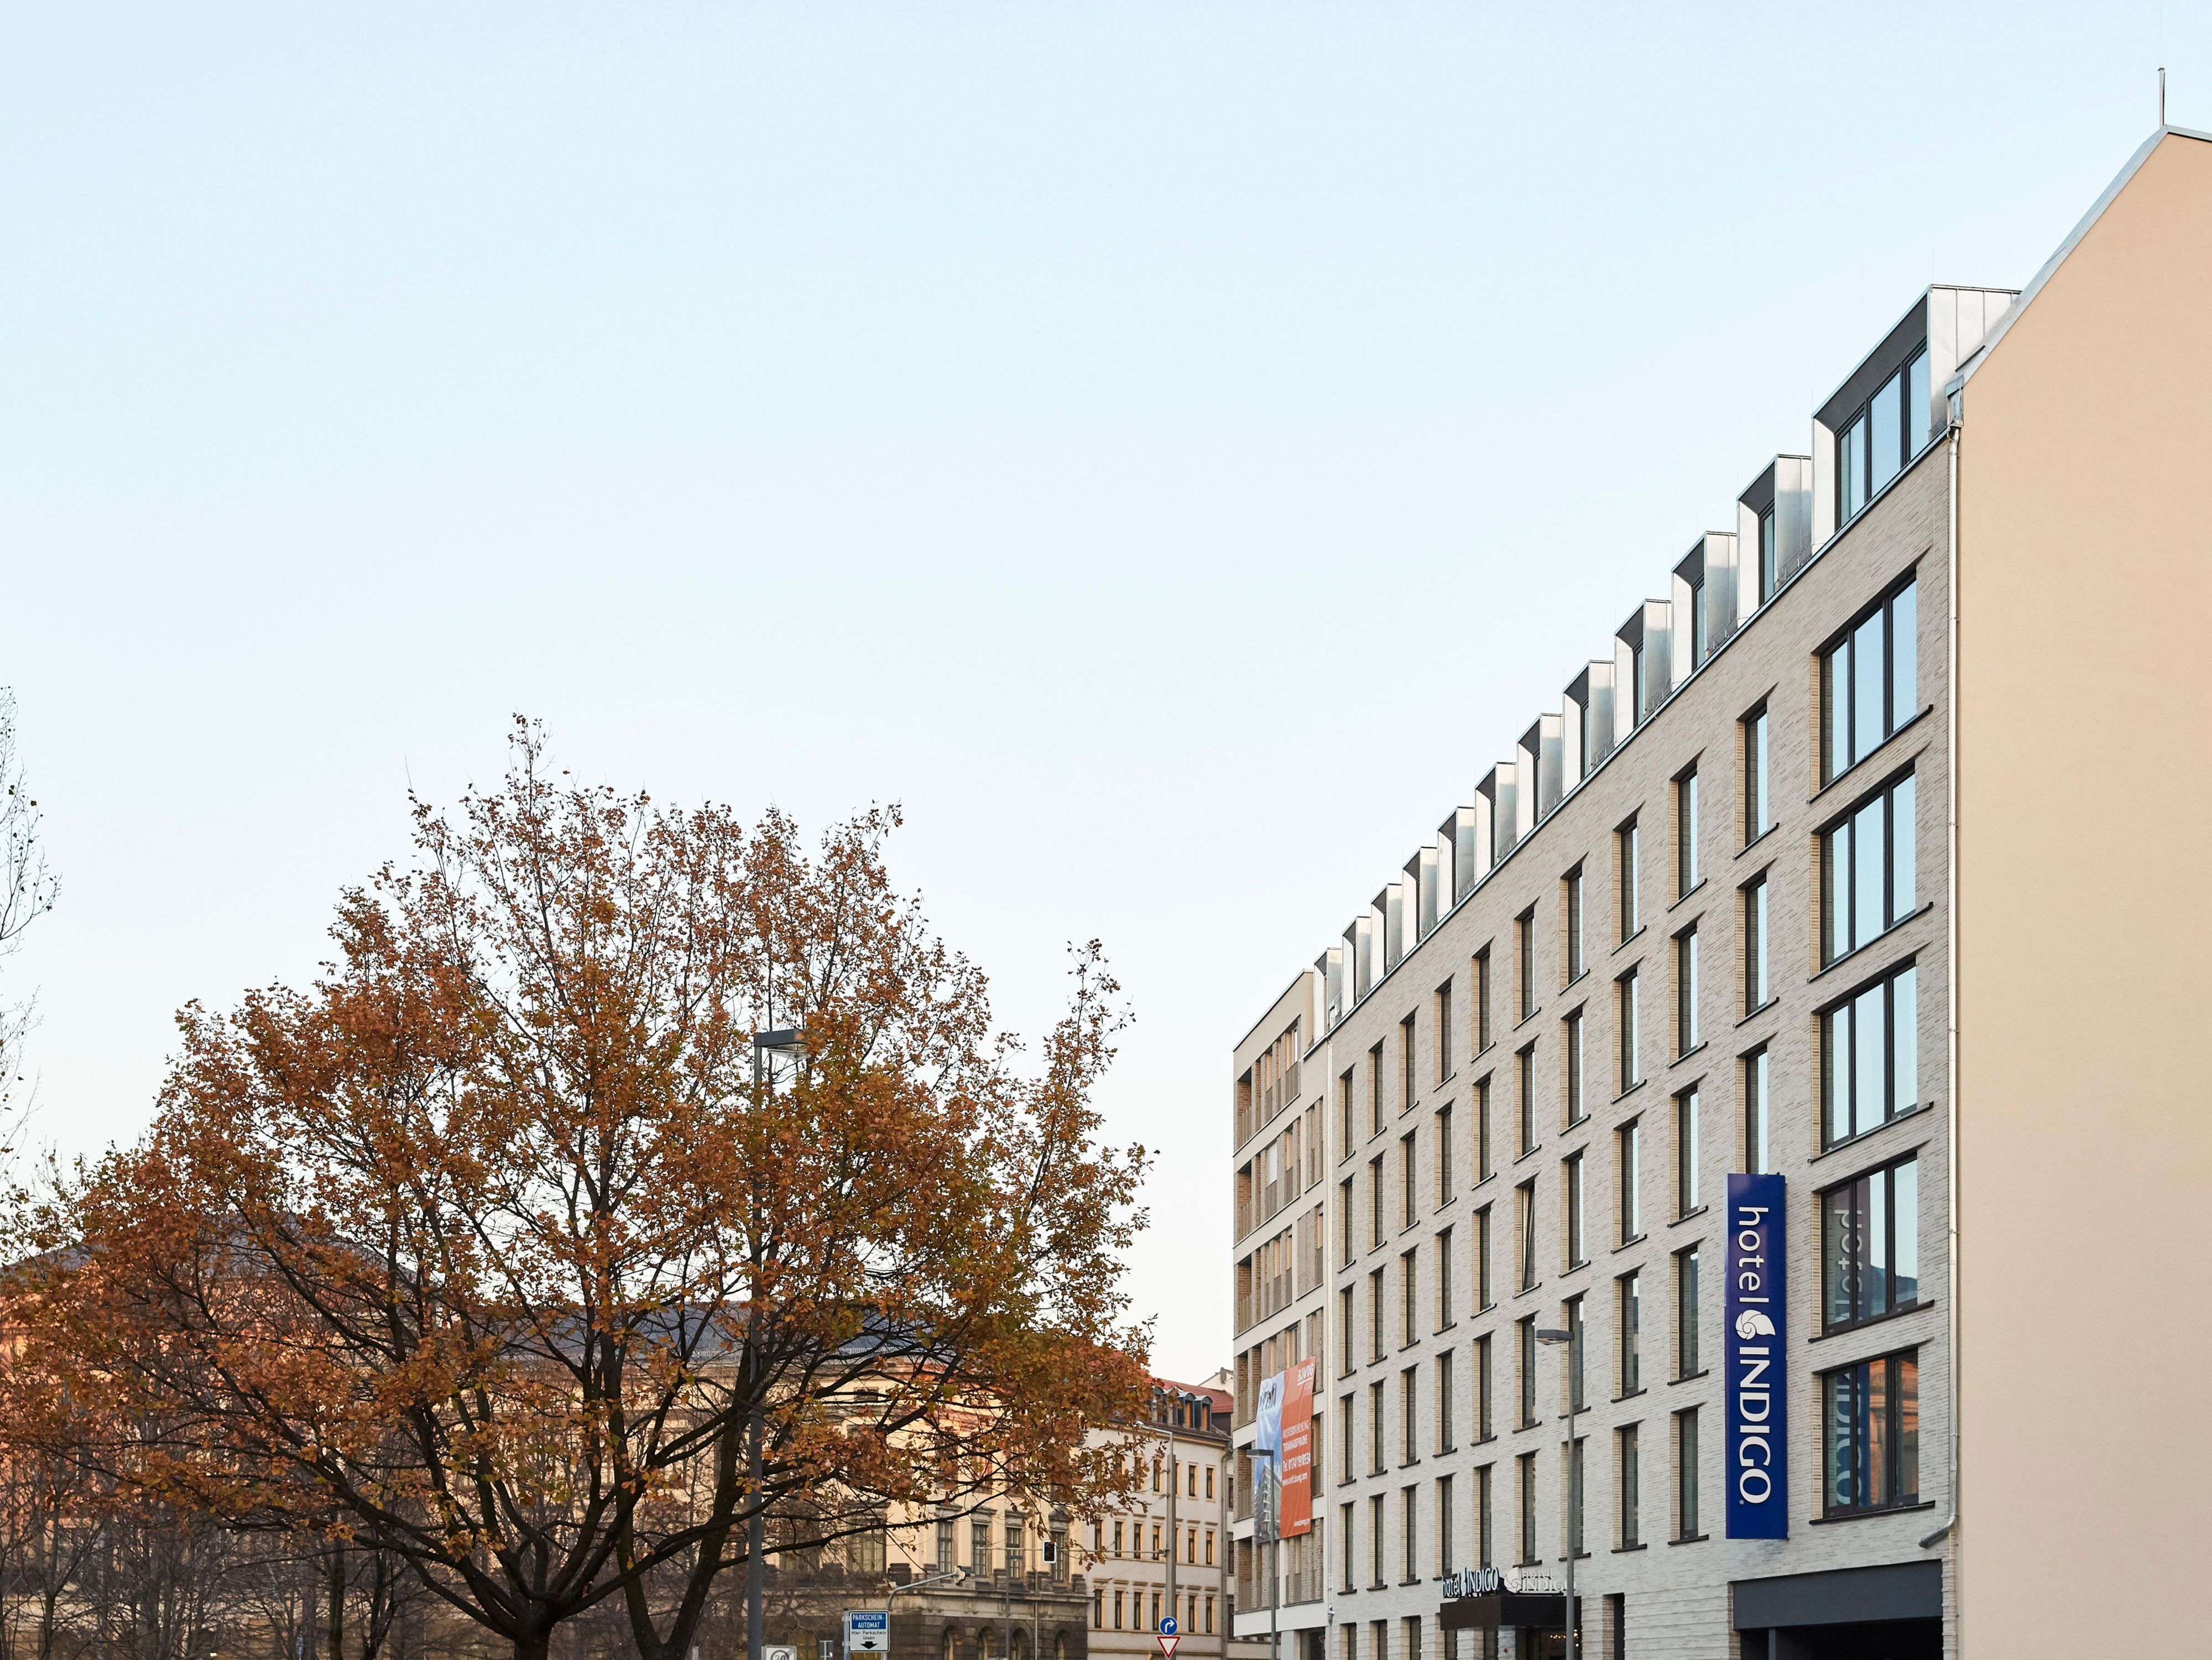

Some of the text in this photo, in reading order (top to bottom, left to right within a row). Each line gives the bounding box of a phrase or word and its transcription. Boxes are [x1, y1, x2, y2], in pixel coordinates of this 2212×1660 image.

[1738, 1206, 1771, 1504] hotel INDIGO
[1442, 1567, 1499, 1597] hotel INDIGO
[1522, 1568, 1552, 1579] hotel
